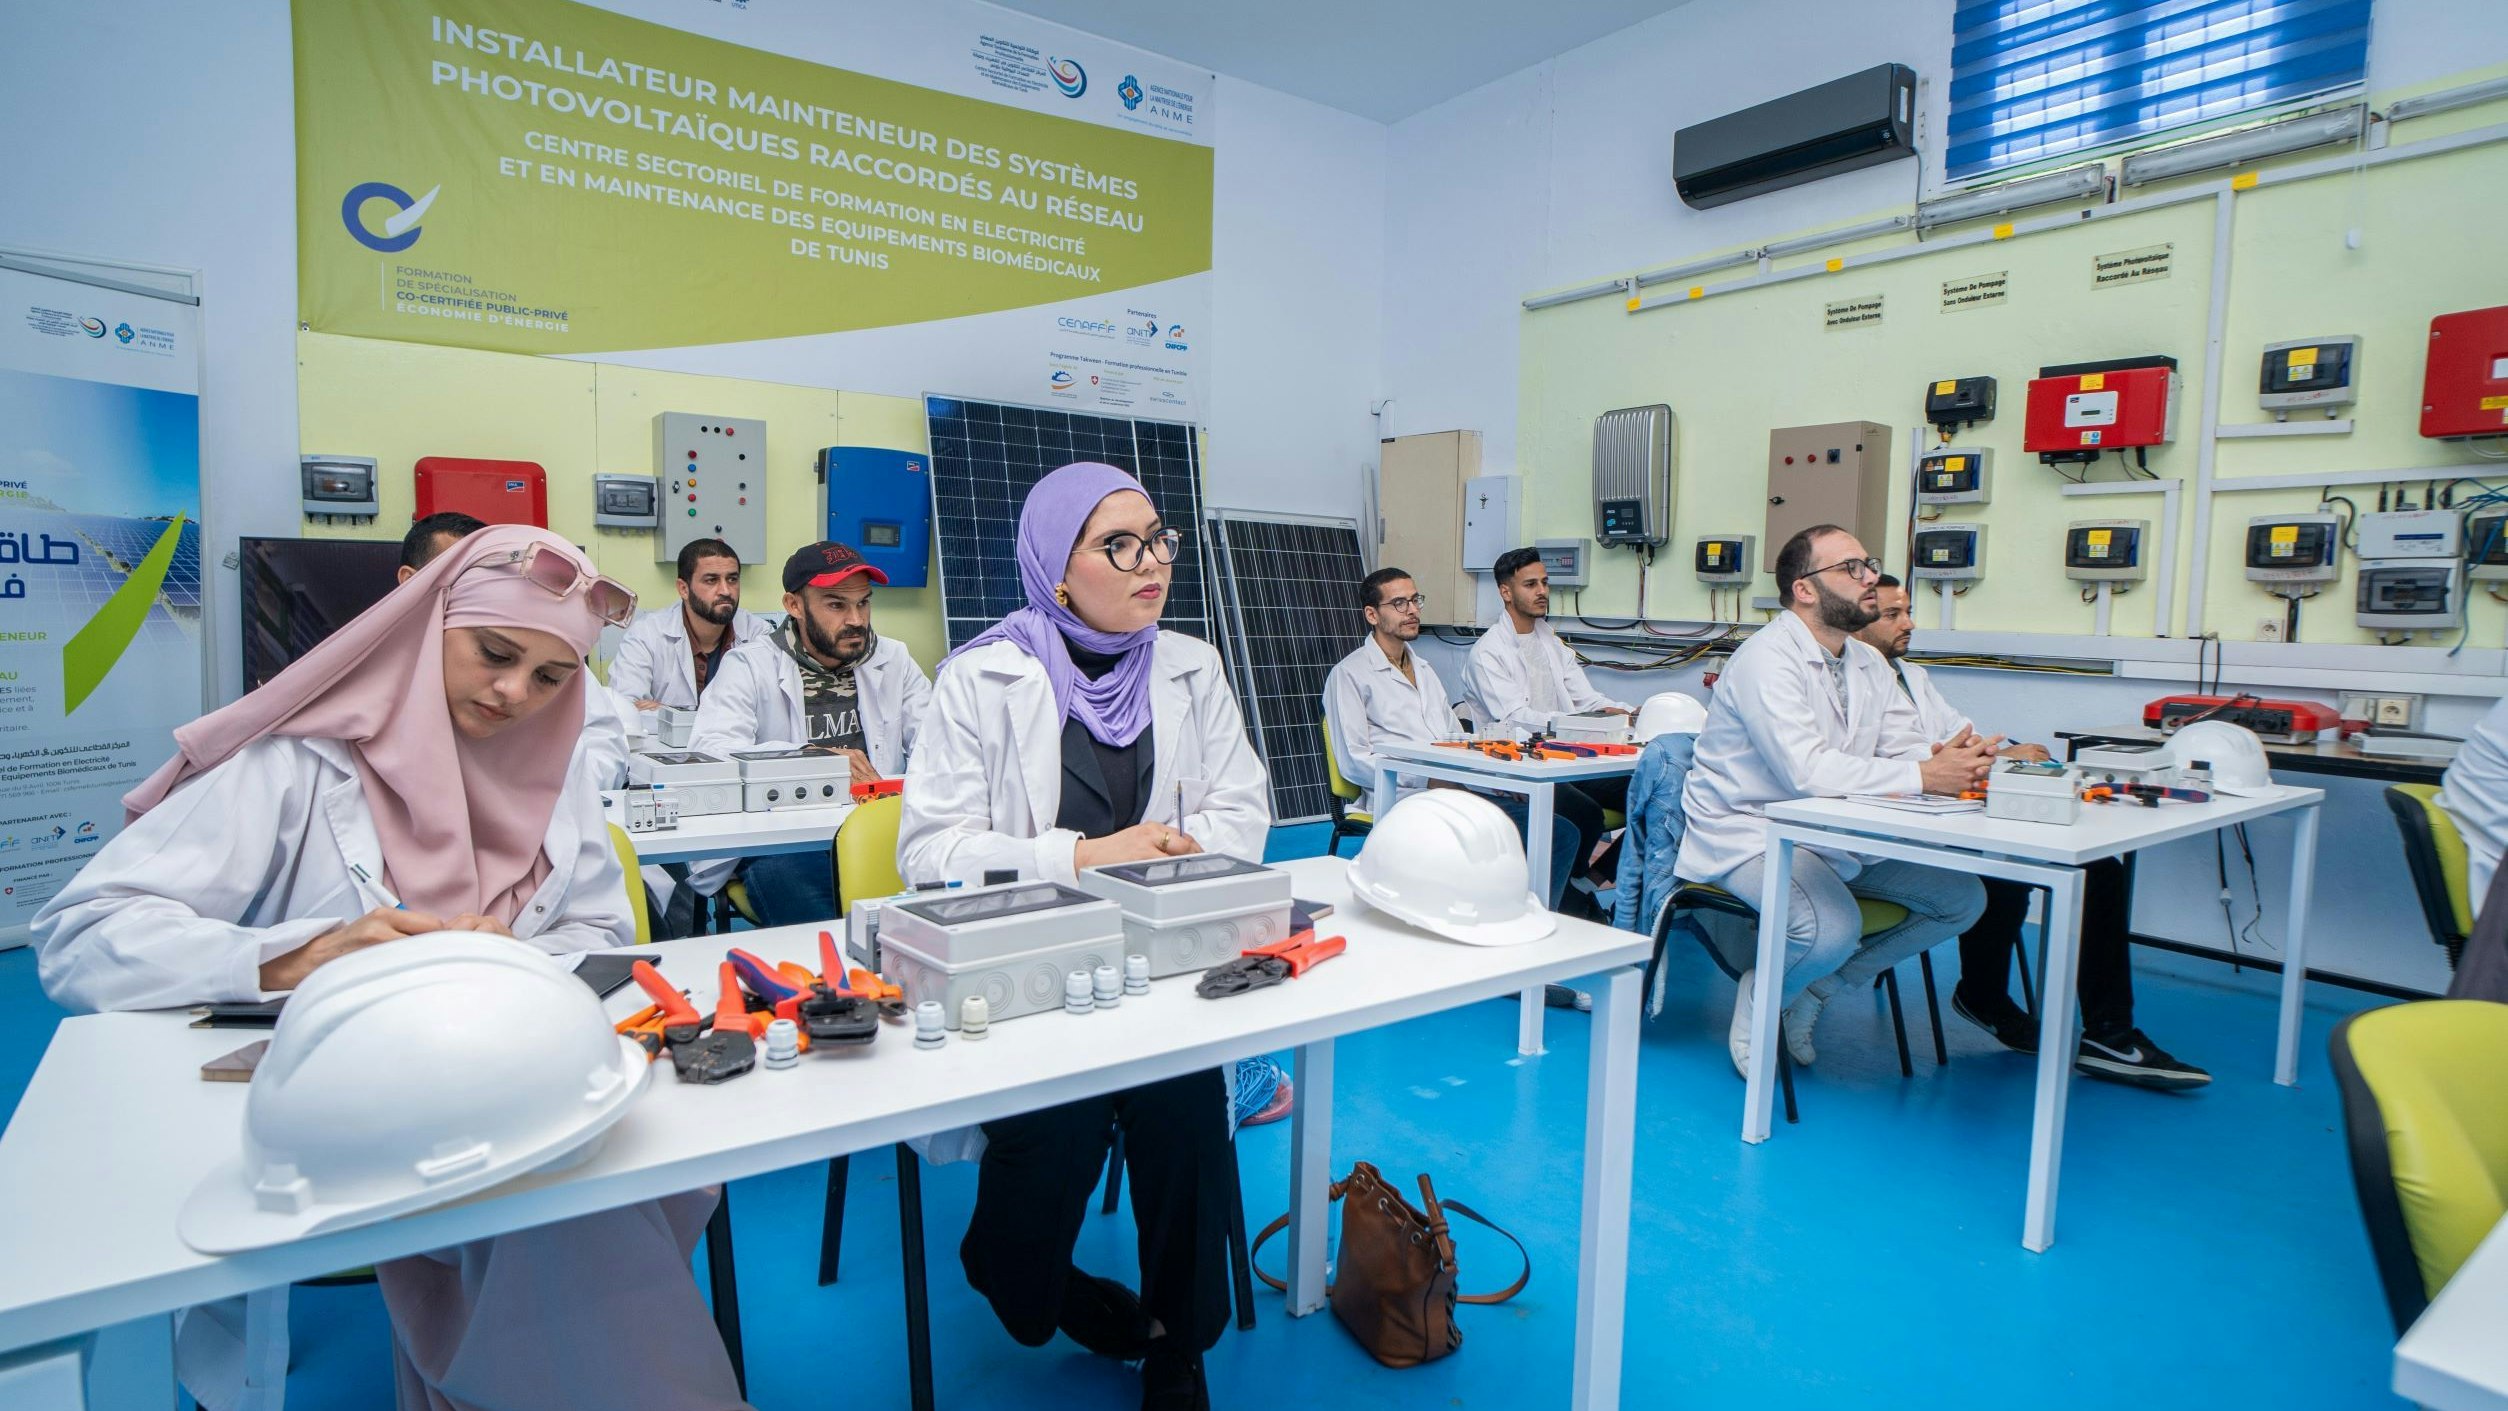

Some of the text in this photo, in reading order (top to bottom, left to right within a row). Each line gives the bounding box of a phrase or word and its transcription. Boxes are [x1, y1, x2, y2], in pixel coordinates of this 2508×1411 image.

[432, 15, 1138, 200] INSTALLATEUR MAINTENEUR DES SYSTÈMES
[432, 60, 1144, 233] PHOTOVOLTAÏQUES RACCORDÉS AU RÉSEAU
[524, 131, 1085, 256] CENTRE SECTORIEL DE FORMATION EN ELECTRICITÉ
[500, 156, 1101, 282] ET EN MAINTENANCE DES EQUIPEMENTS BIOMÉDICAUX
[791, 238, 889, 270] DE TUNIS
[396, 266, 472, 284] FORMATION
[396, 278, 517, 302] DE SPÉCIALISATION
[396, 291, 569, 321] CO-CERTIFIÉE PUBLIC-PRIVÉ
[1127, 308, 1157, 319] Partenaires
[1050, 352, 1079, 361] Programme
[1104, 360, 1129, 368] Formation
[1129, 363, 1164, 374] professionnelle
[805, 708, 863, 740] LMA
[1, 760, 137, 781] Equipements Biomédicaux de Tunis
[20, 762, 61, 771] Formation
[74, 756, 110, 766] Electricité
[0, 861, 43, 872] FORMATION
